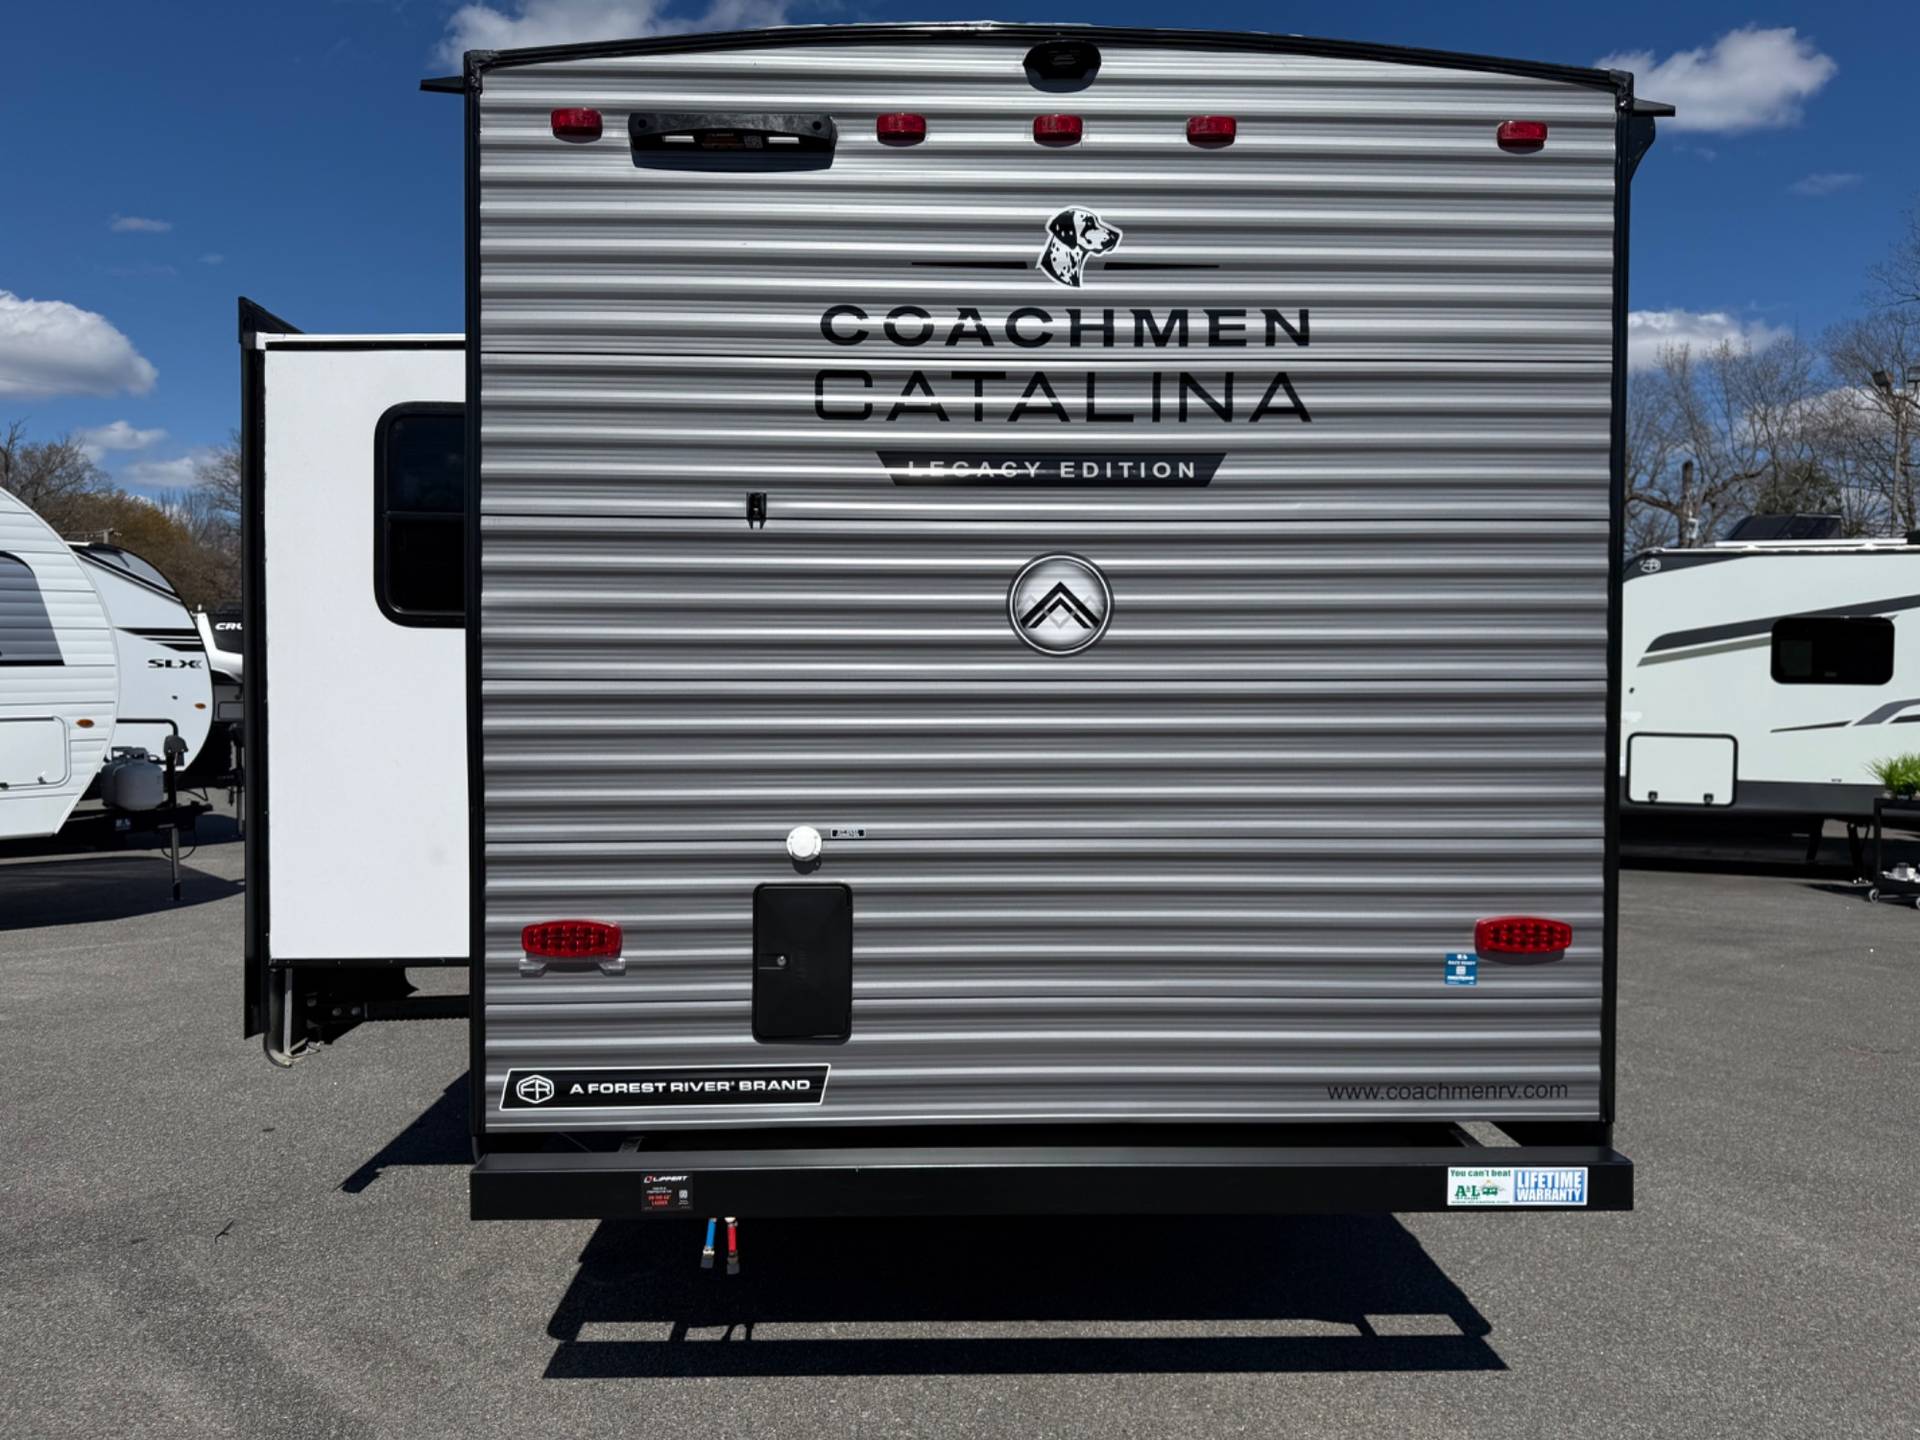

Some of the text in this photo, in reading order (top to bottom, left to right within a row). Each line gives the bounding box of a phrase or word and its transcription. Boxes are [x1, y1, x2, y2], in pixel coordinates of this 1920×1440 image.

[820, 305, 1310, 348] COACHMEN
[814, 369, 1312, 423] CATALINA
[908, 461, 1195, 479] LEGACY EDITION
[570, 1083, 585, 1094] A
[588, 1082, 666, 1094] FOREST
[740, 1080, 811, 1091] BRAND
[1327, 1082, 1568, 1100] www.coachmenrv.com
[1450, 1169, 1511, 1177] You can't beat
[1517, 1172, 1583, 1188] LIFETIME
[1517, 1188, 1582, 1201] WARRANTY
